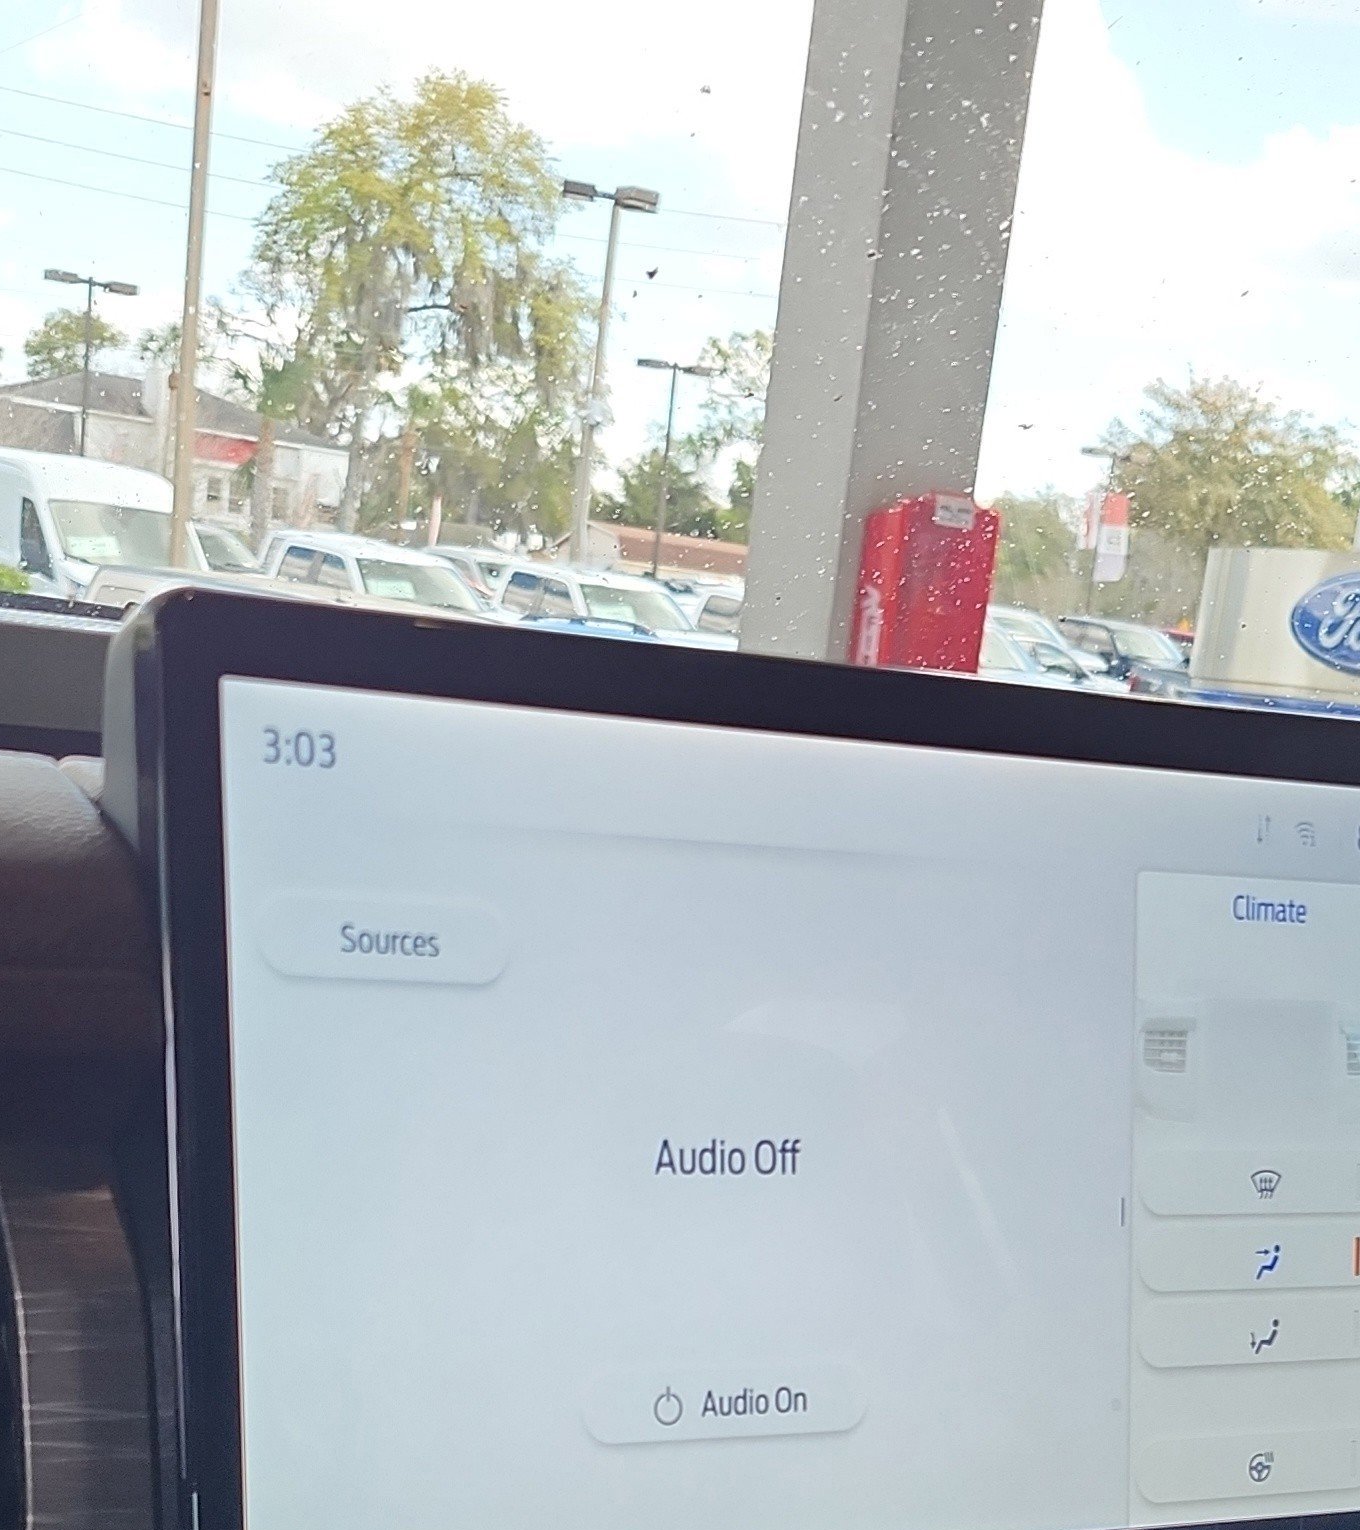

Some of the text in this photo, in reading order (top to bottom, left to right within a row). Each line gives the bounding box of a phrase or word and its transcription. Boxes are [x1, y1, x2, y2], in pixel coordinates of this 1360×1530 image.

[261, 727, 337, 769] 3:03
[1232, 894, 1308, 925] Climate
[339, 922, 441, 959] Sources
[654, 1137, 801, 1176] Audio Off
[700, 1386, 808, 1418] Audio On
